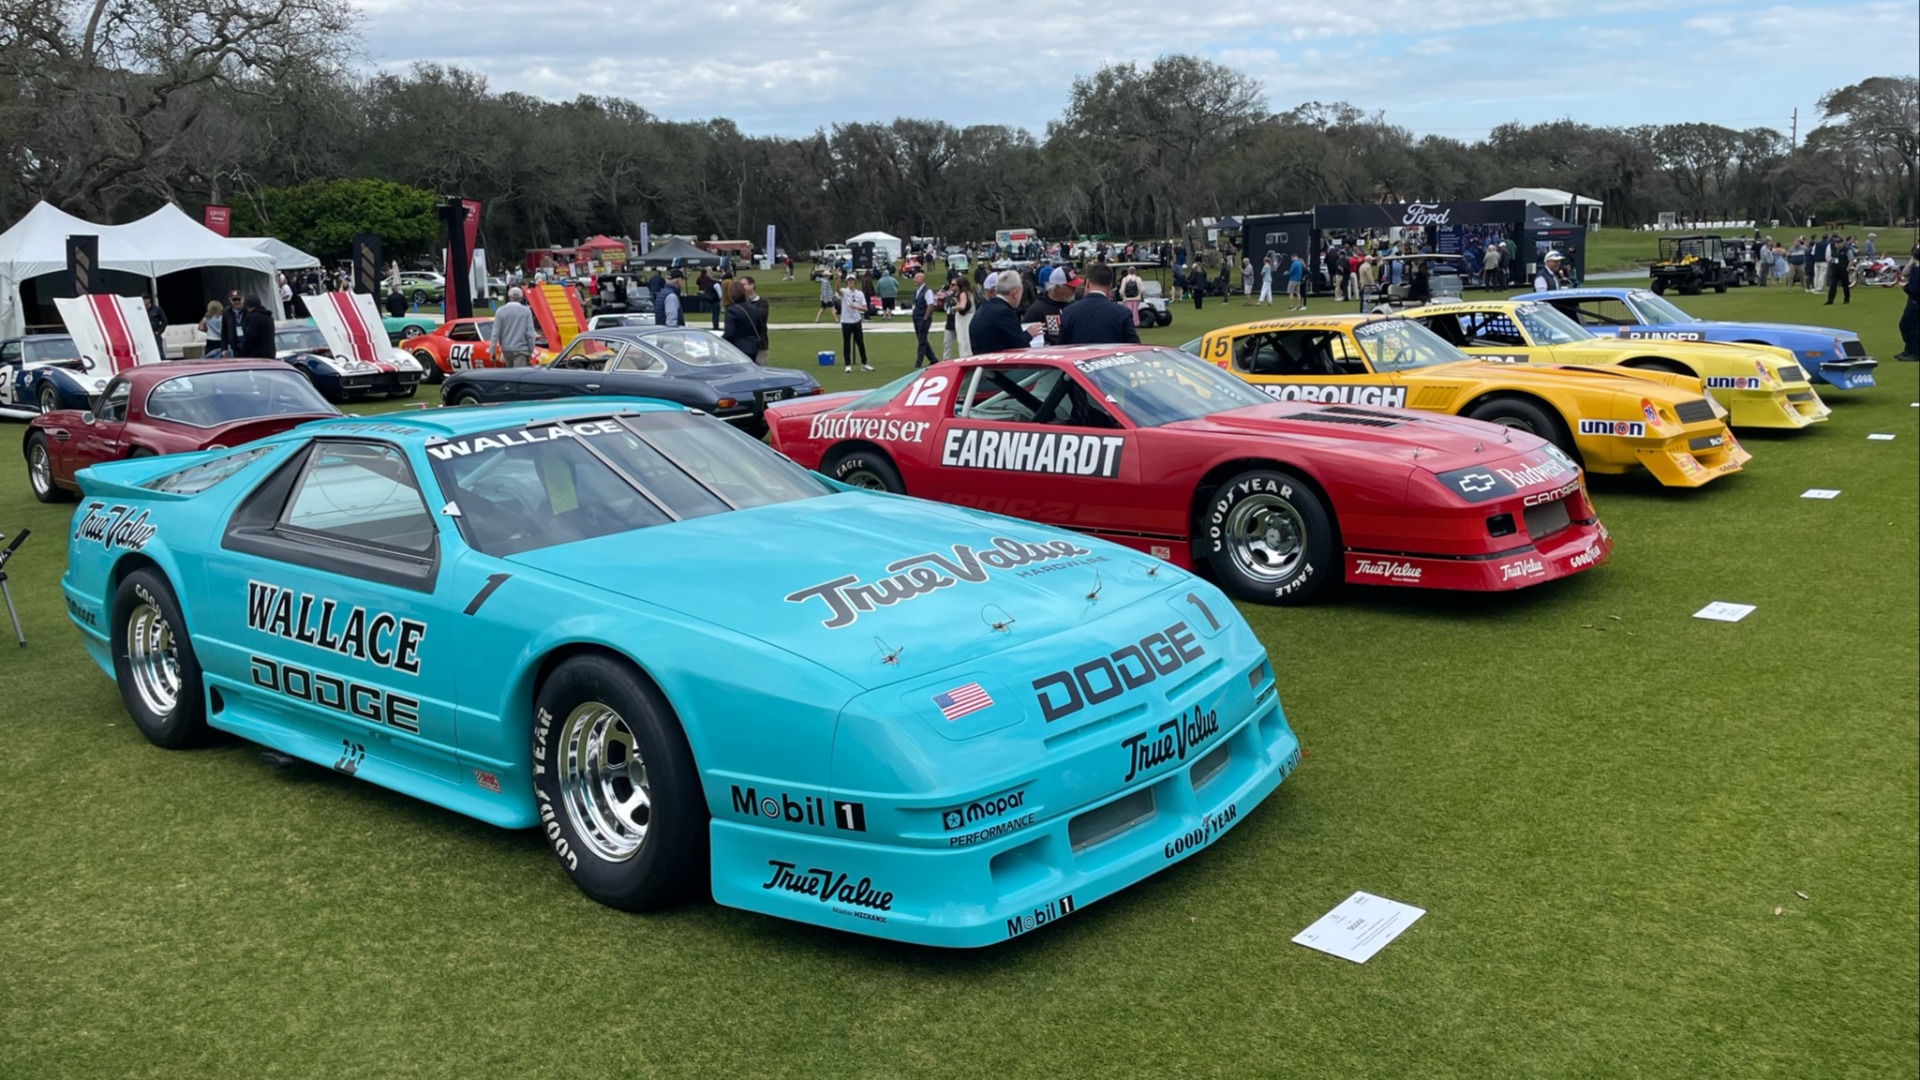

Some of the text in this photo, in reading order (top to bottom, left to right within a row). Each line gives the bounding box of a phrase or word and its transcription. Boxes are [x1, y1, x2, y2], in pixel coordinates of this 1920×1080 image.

[1402, 203, 1451, 225] Ford
[451, 345, 471, 369] 94
[1203, 335, 1230, 359] 15
[904, 376, 949, 406] 12
[427, 421, 623, 460] WALLACE
[808, 412, 930, 443] Budweiser
[836, 460, 863, 478] EAGLE
[941, 429, 1124, 478] EARNHARDT
[463, 573, 512, 615] 1
[1275, 563, 1314, 597] EAGLE
[248, 580, 426, 676] WALLACE
[1187, 593, 1221, 631] 1
[1031, 620, 1205, 724] DODGE
[250, 654, 419, 734] DODGE
[731, 784, 860, 831] Mobil 1
[949, 813, 1035, 846] PERFORMANCE
[1006, 896, 1073, 937] Mobil 1
